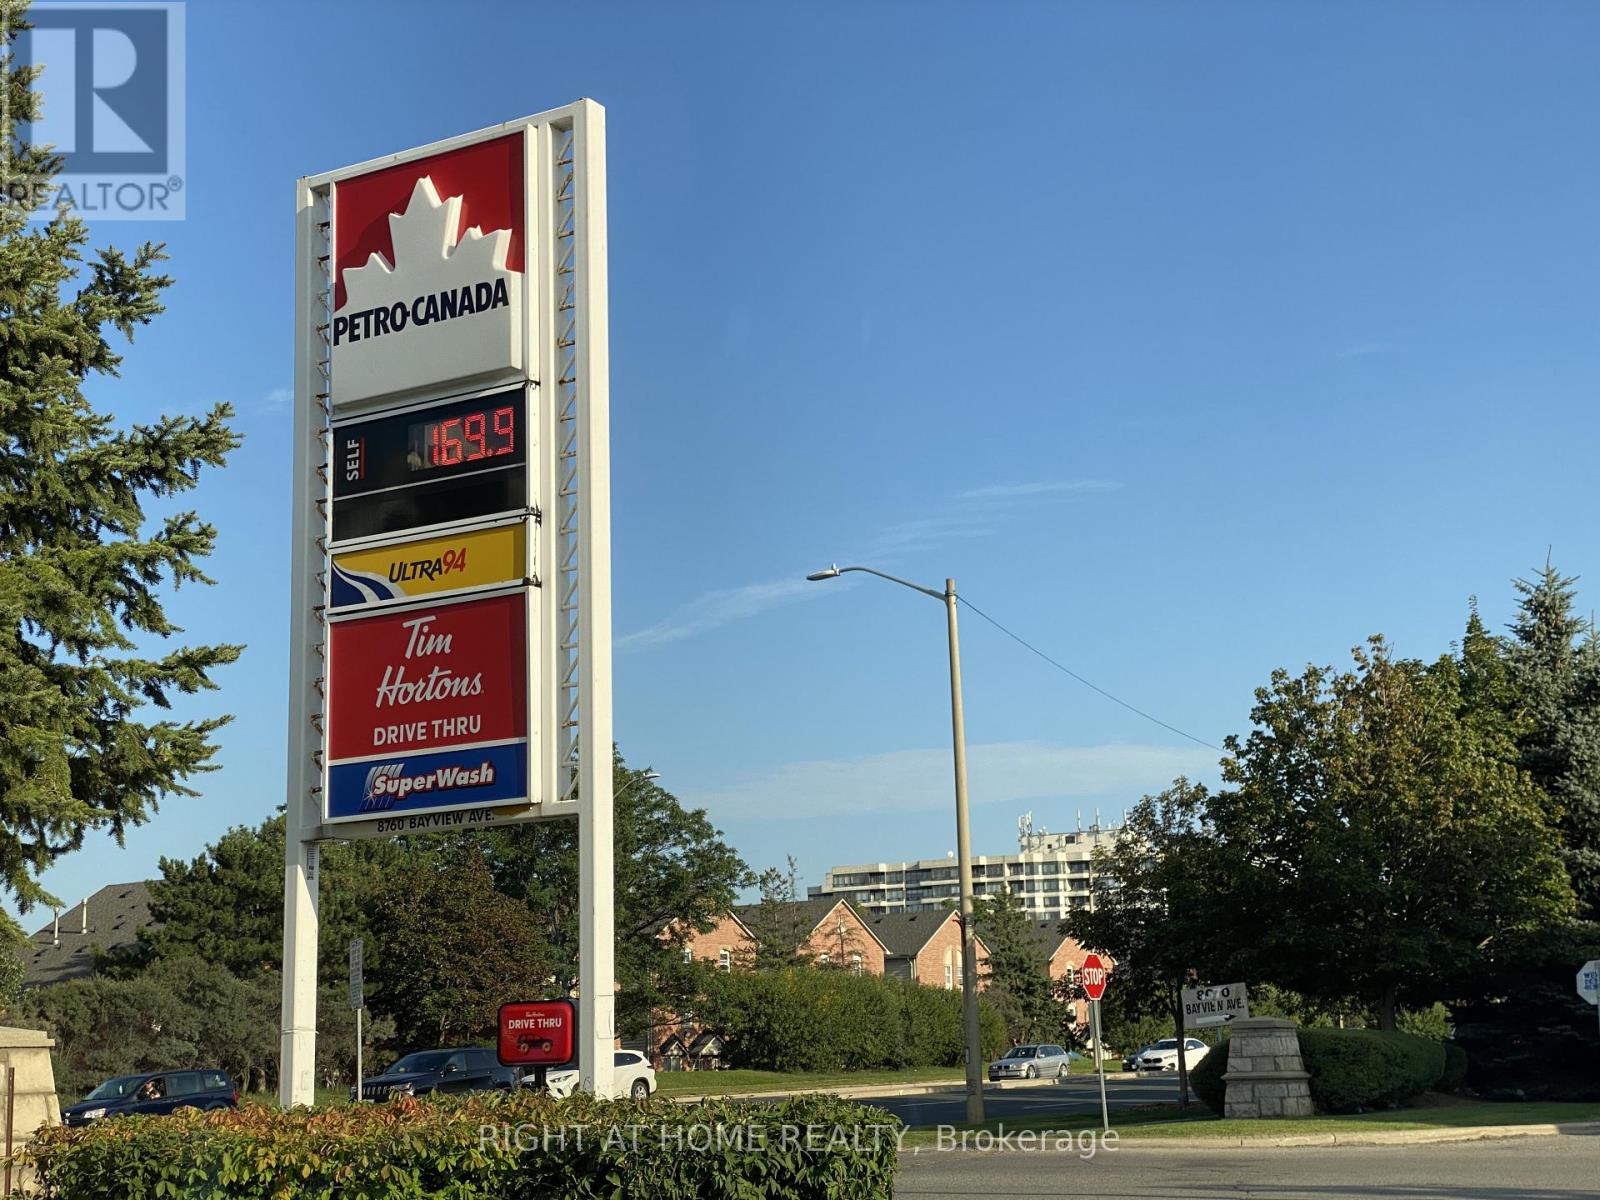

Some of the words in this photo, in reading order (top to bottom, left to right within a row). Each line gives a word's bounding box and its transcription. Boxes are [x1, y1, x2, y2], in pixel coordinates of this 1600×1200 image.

[431, 406, 514, 466] 169.9
[346, 438, 360, 481] SELF
[402, 615, 453, 660] Tim
[375, 665, 483, 709] Hortons
[373, 721, 427, 747] DRIVE
[431, 714, 481, 739] THRU
[373, 762, 495, 796] SuperWash
[377, 819, 405, 833] 8760
[409, 811, 464, 830] BAYVIEW
[468, 808, 496, 824] AVE.
[1084, 967, 1104, 986] STOP
[1227, 998, 1245, 1011] AVE.
[508, 1019, 536, 1030] DRIVE
[537, 1017, 562, 1029] THRU
